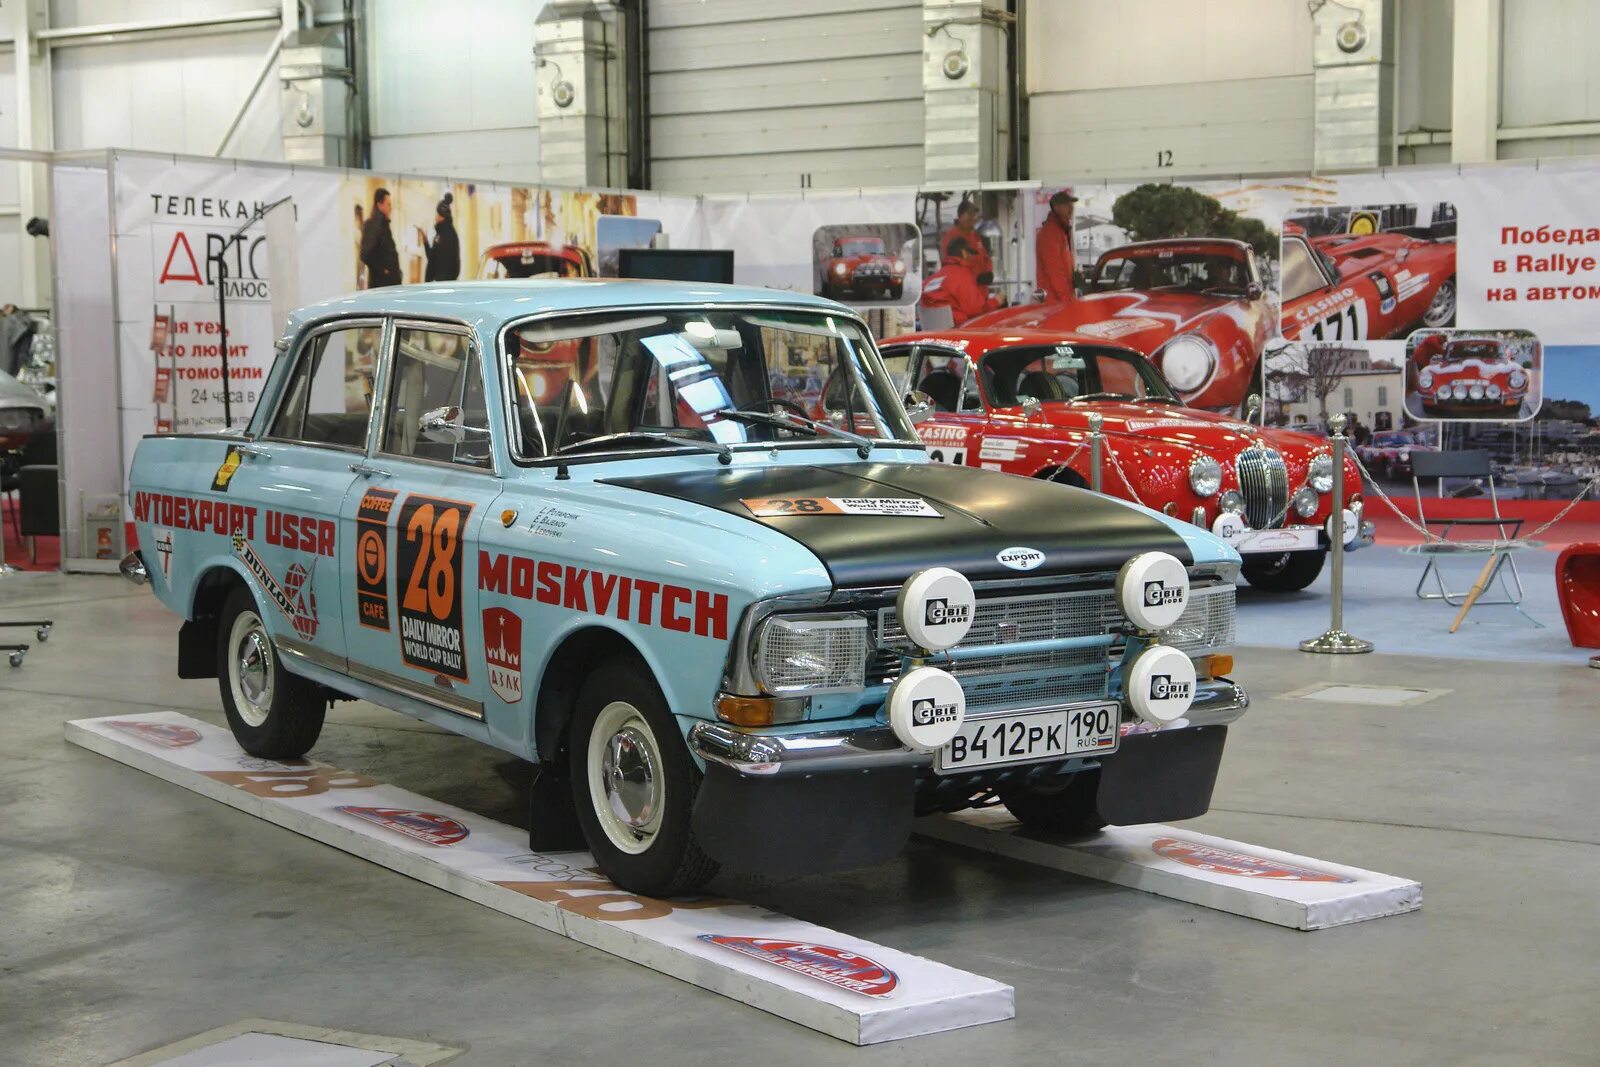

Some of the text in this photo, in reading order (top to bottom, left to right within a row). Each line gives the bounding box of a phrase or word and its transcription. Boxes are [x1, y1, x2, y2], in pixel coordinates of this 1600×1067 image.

[1157, 149, 1174, 167] 12
[800, 173, 812, 189] 11
[151, 194, 298, 222] ТЕЛЕКАН
[1501, 225, 1600, 245] Победа
[1493, 253, 1597, 275] в Rallye
[1487, 286, 1600, 301] на автом
[191, 345, 249, 357] люит
[176, 367, 263, 380] томоили
[191, 388, 208, 404] 24
[247, 391, 256, 402] в
[361, 495, 394, 513] COFFEE
[767, 499, 824, 513] 28
[842, 498, 877, 506] Daily
[134, 491, 258, 541] AVTOEXPORT
[265, 510, 336, 557] USSR
[402, 503, 460, 620] 28
[1000, 553, 1041, 562] EXPORT
[243, 548, 296, 616] DUNLOP
[478, 550, 728, 640] MOSKVITCH
[362, 602, 386, 620] CAFE
[947, 616, 969, 624] IODE
[401, 615, 461, 653] DAILY MIRROR
[403, 639, 462, 670] WORLD CUP RALLY
[936, 715, 958, 723] IODE
[1070, 709, 1110, 738] 190
[1077, 736, 1098, 748] RUS
